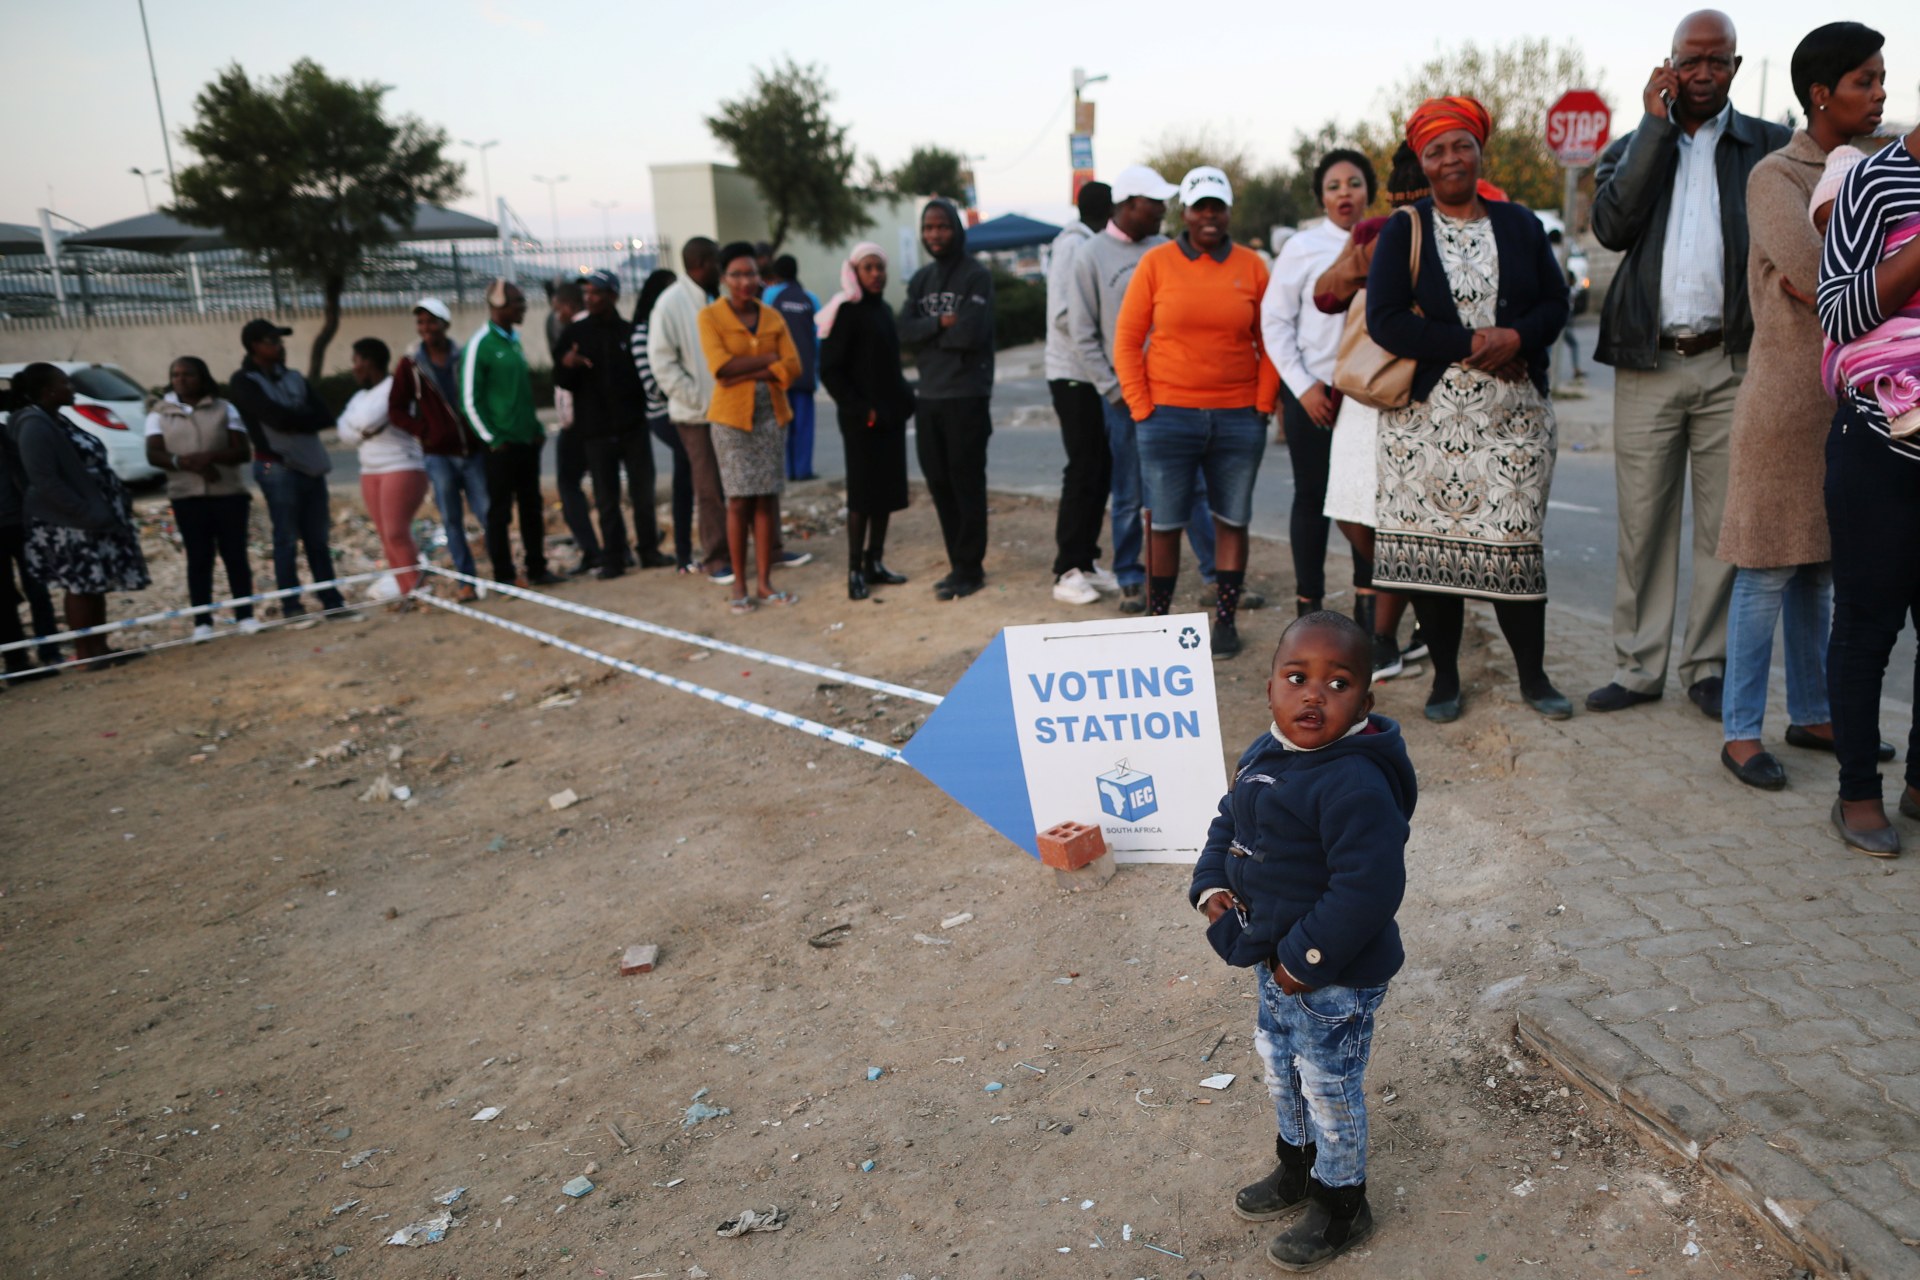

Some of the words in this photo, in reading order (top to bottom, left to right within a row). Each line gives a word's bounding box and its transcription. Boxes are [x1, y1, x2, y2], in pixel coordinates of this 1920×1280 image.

[1549, 111, 1607, 143] STOP
[1028, 664, 1194, 704] VOTING
[1034, 711, 1201, 744] STATION
[1129, 785, 1154, 809] IEC
[1106, 826, 1133, 835] SOUTH
[1134, 826, 1162, 834] AFRICA
